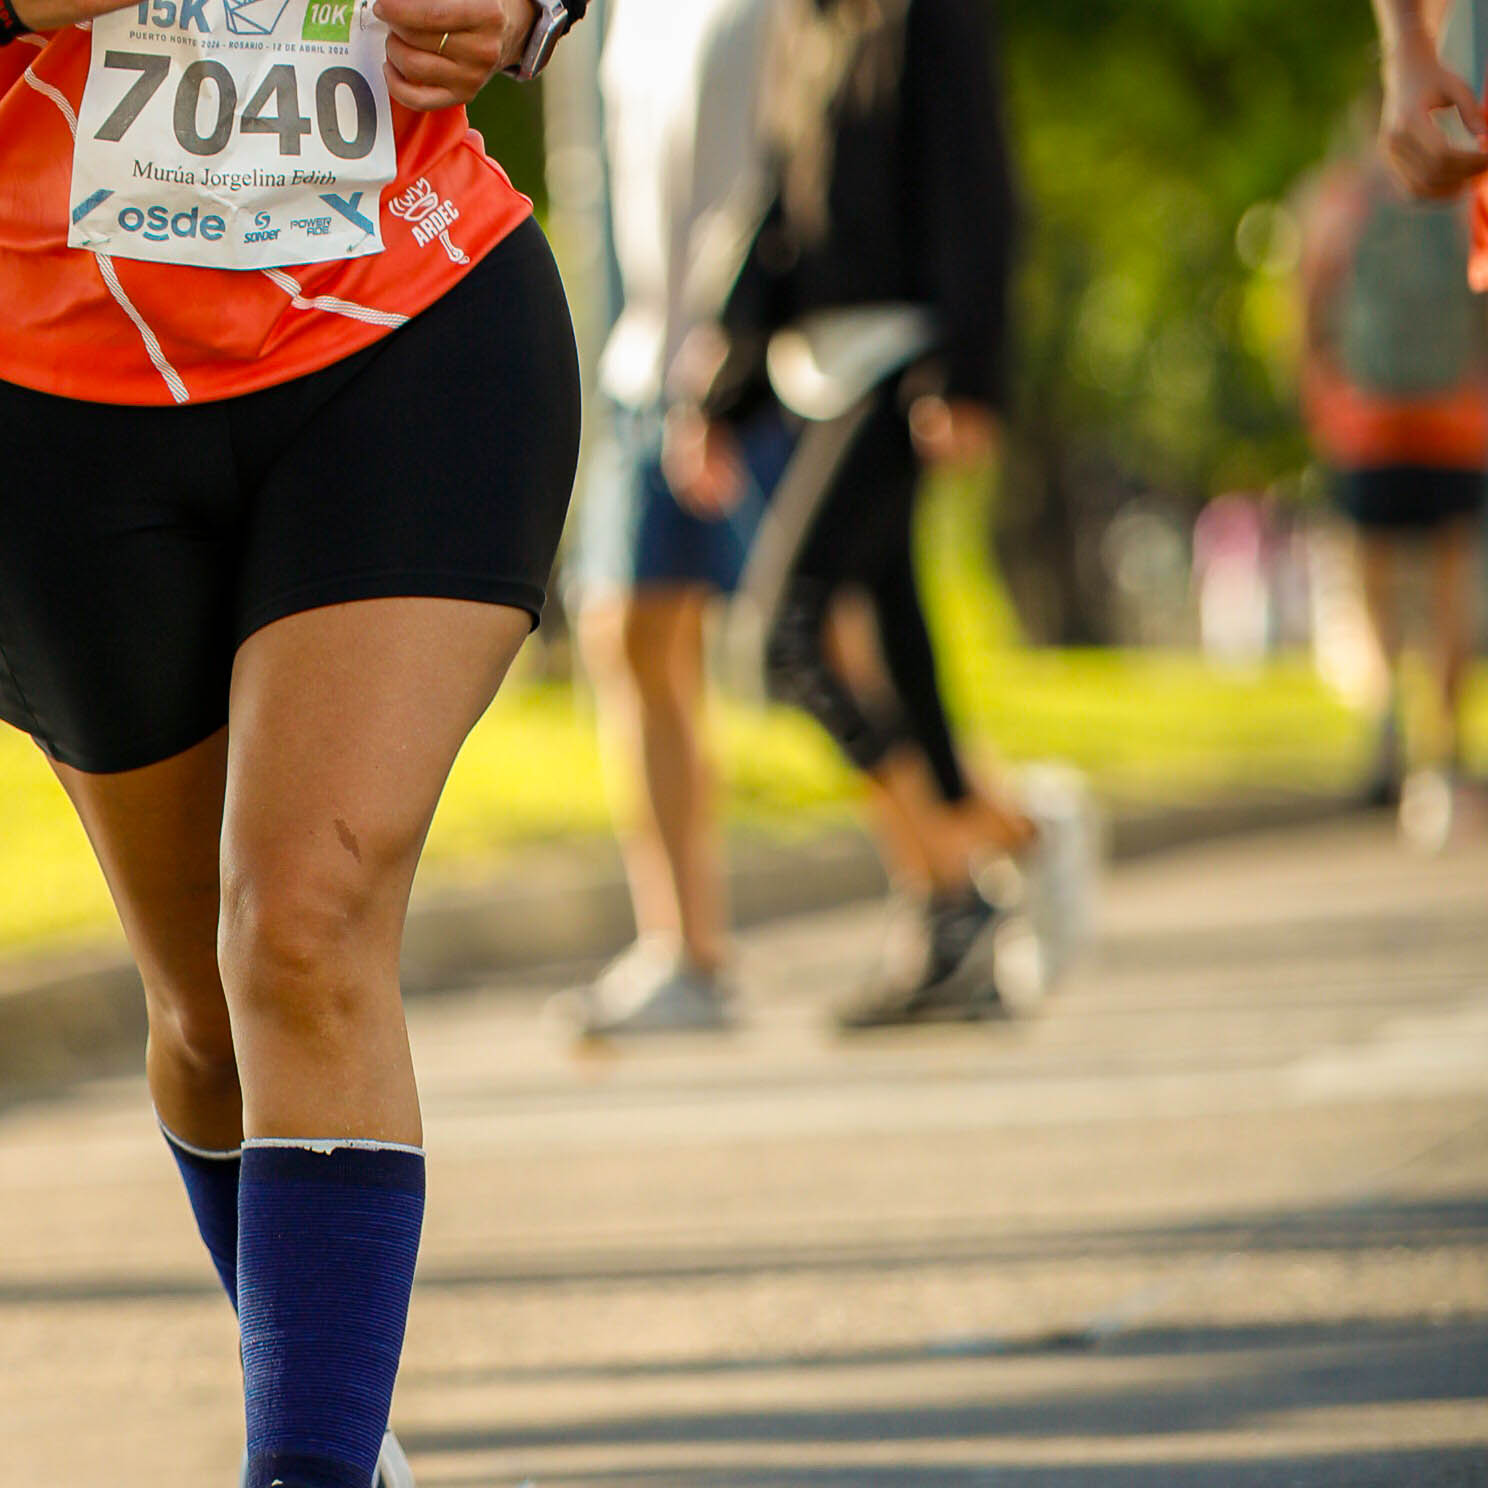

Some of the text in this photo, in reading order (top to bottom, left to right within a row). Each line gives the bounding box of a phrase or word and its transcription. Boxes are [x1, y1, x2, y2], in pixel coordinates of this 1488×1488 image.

[311, 2, 348, 25] 10K
[129, 30, 167, 42] PUERTO
[169, 35, 198, 48] NORTE
[200, 40, 220, 49] 2026
[228, 40, 264, 50] ROSARIO
[272, 42, 282, 52] 12
[285, 43, 297, 52] DE
[299, 44, 325, 54] ABRIL
[328, 45, 350, 56] 2026
[94, 49, 378, 160] 7040
[131, 159, 337, 191] Murúa Jorgelina Edith
[118, 205, 226, 241] osde
[411, 199, 460, 248] ARDEC
